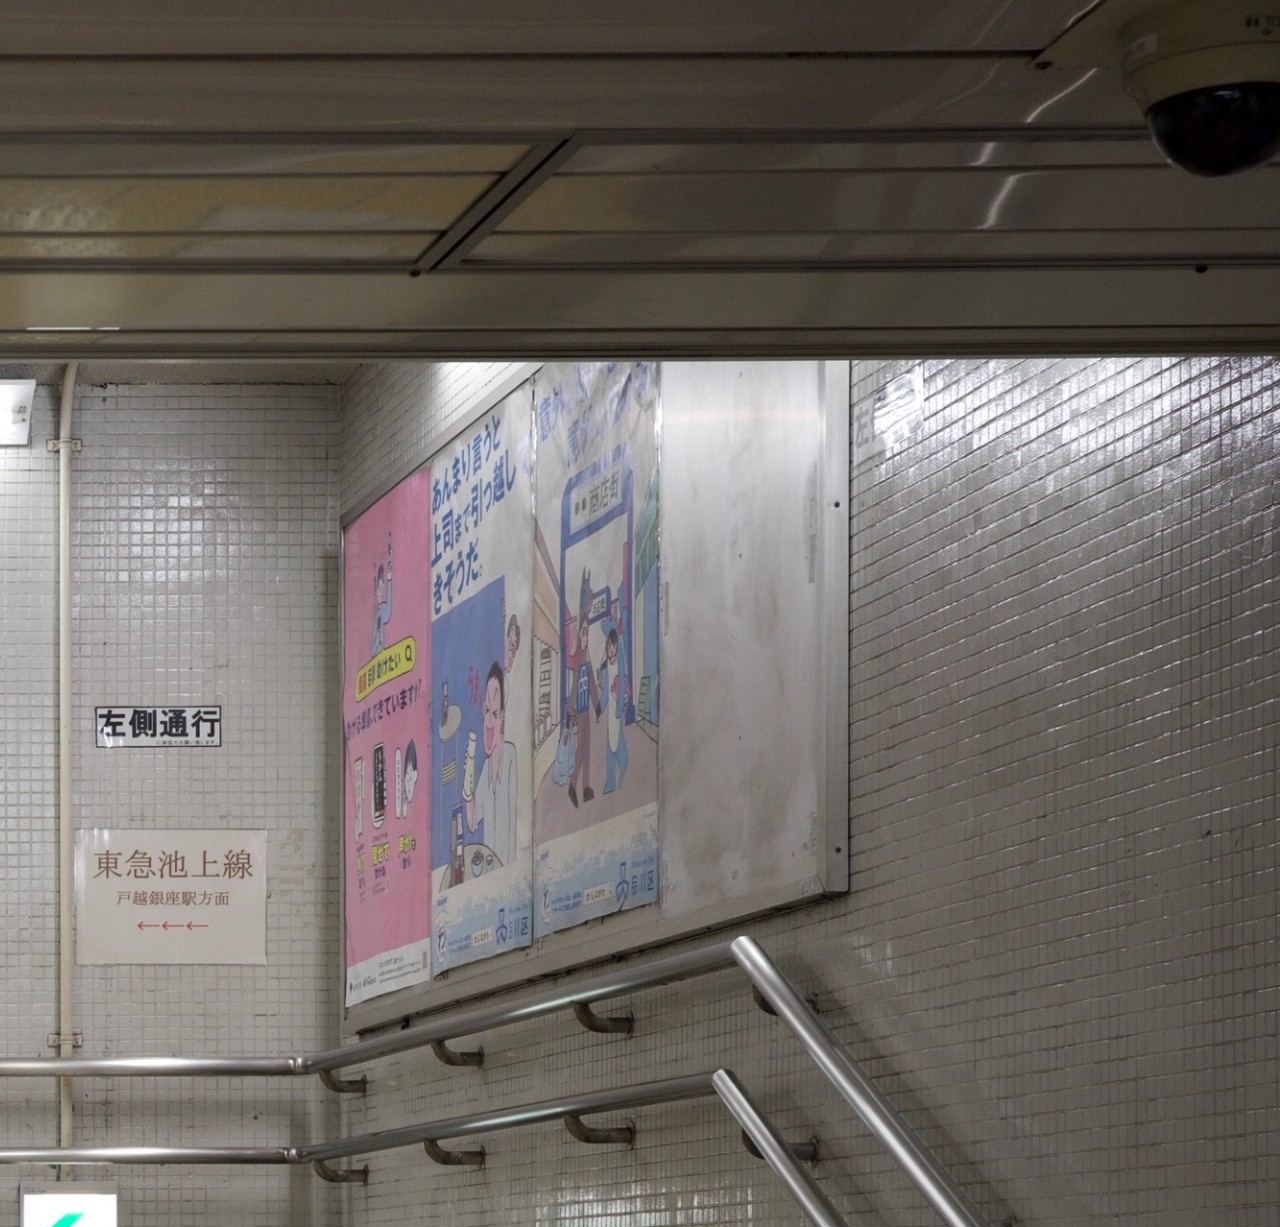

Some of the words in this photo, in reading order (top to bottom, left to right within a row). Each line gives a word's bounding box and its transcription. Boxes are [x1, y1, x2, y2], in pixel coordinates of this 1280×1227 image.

[432, 414, 500, 516] あんまり言うと
[431, 449, 516, 568] 上司まで引っ越し
[433, 540, 484, 617] きそうだ。
[98, 709, 220, 738] 左側通行
[92, 849, 254, 880] 東急池上線
[116, 890, 230, 906] 戸越銀座駅方面
